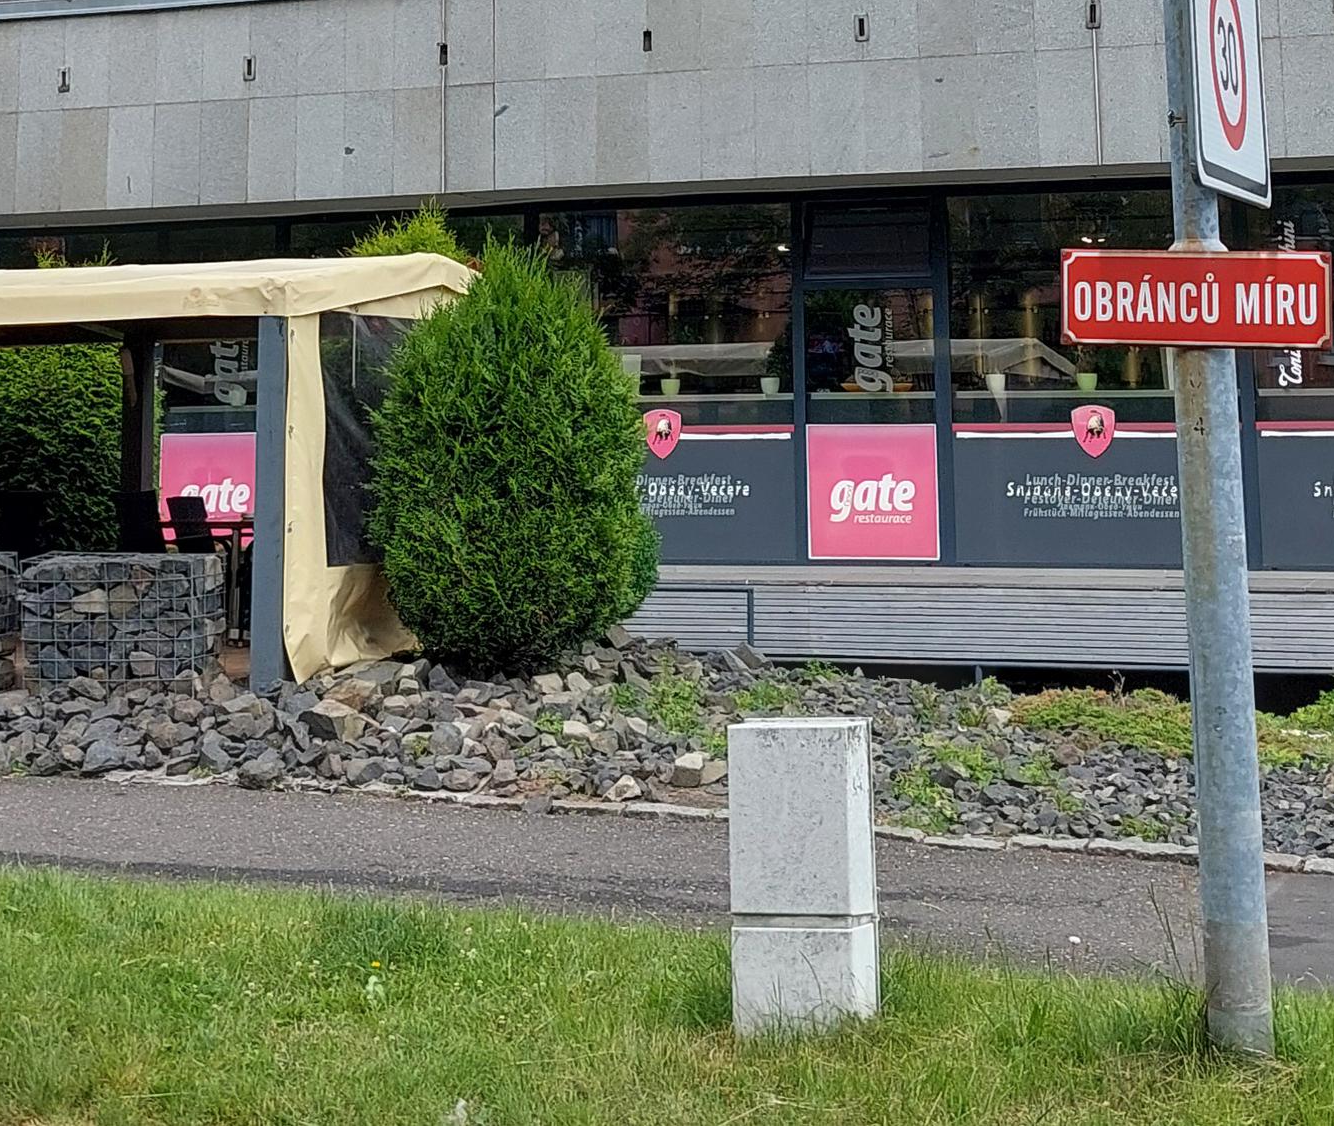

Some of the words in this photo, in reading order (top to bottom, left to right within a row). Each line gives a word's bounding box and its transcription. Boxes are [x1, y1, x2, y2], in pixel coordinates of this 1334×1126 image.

[1217, 16, 1239, 96] 30
[1074, 272, 1220, 324] OBRÁNCŮ
[1236, 276, 1318, 326] MÍRU
[847, 304, 894, 393] gate
[830, 473, 915, 522] gate
[854, 514, 912, 524] restaurace
